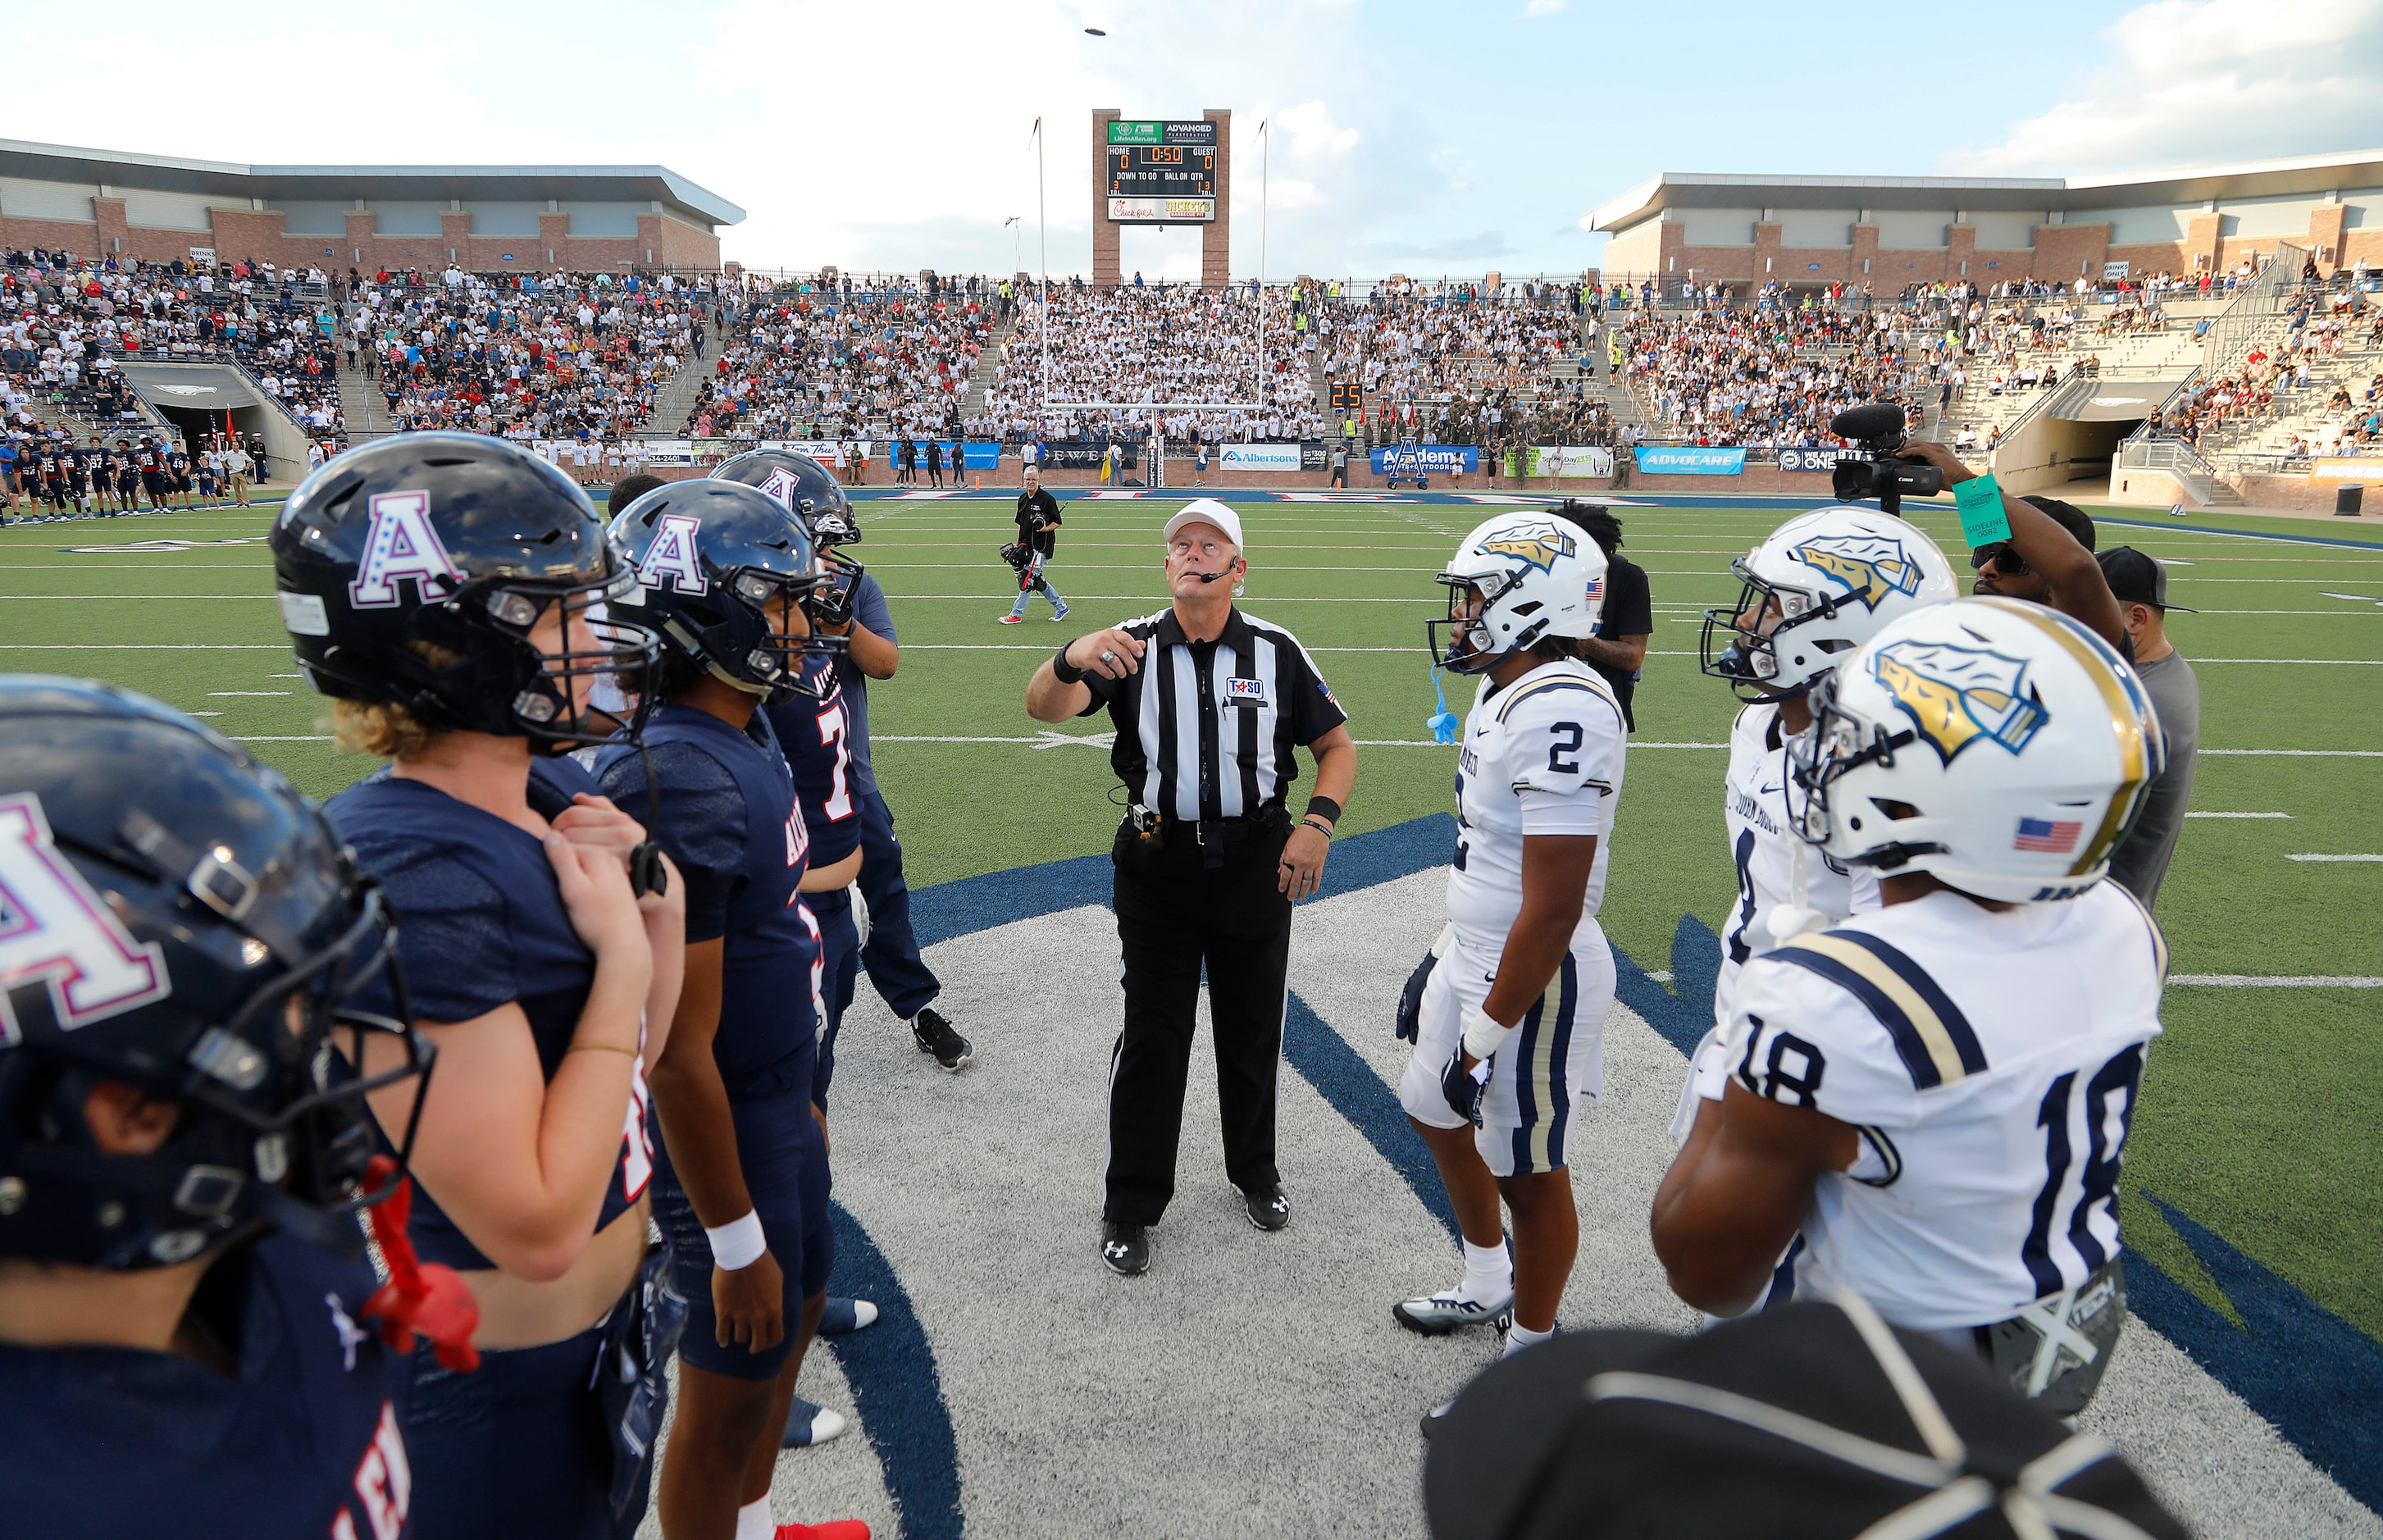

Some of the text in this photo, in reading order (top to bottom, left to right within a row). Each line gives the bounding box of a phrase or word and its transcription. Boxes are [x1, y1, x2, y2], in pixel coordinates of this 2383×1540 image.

[1166, 124, 1212, 132] ADVANCED
[1152, 148, 1181, 162] 0:50
[1193, 148, 1214, 156] GUEST
[1120, 155, 1128, 169] 0
[1205, 156, 1213, 170] 0
[1117, 172, 1157, 180] DOWN TO GO
[1164, 172, 1204, 180] BALL ON QTR
[1114, 180, 1119, 189] 3
[1205, 180, 1210, 190] 3
[1165, 201, 1210, 212] DICKEY'S
[1333, 385, 1360, 406] 25
[1242, 453, 1298, 462] Albertsons
[1647, 455, 1733, 466] ADVOCARE
[90, 458, 103, 469] 97
[173, 460, 184, 468] 49
[1805, 458, 1838, 470] ONE
[1967, 517, 2004, 534] SIDELINE
[1977, 527, 1998, 538] 0082
[349, 489, 470, 610] A
[636, 513, 709, 598] A
[1547, 721, 1584, 774] 2
[814, 702, 854, 822] 7
[1738, 1013, 1827, 1110] 18
